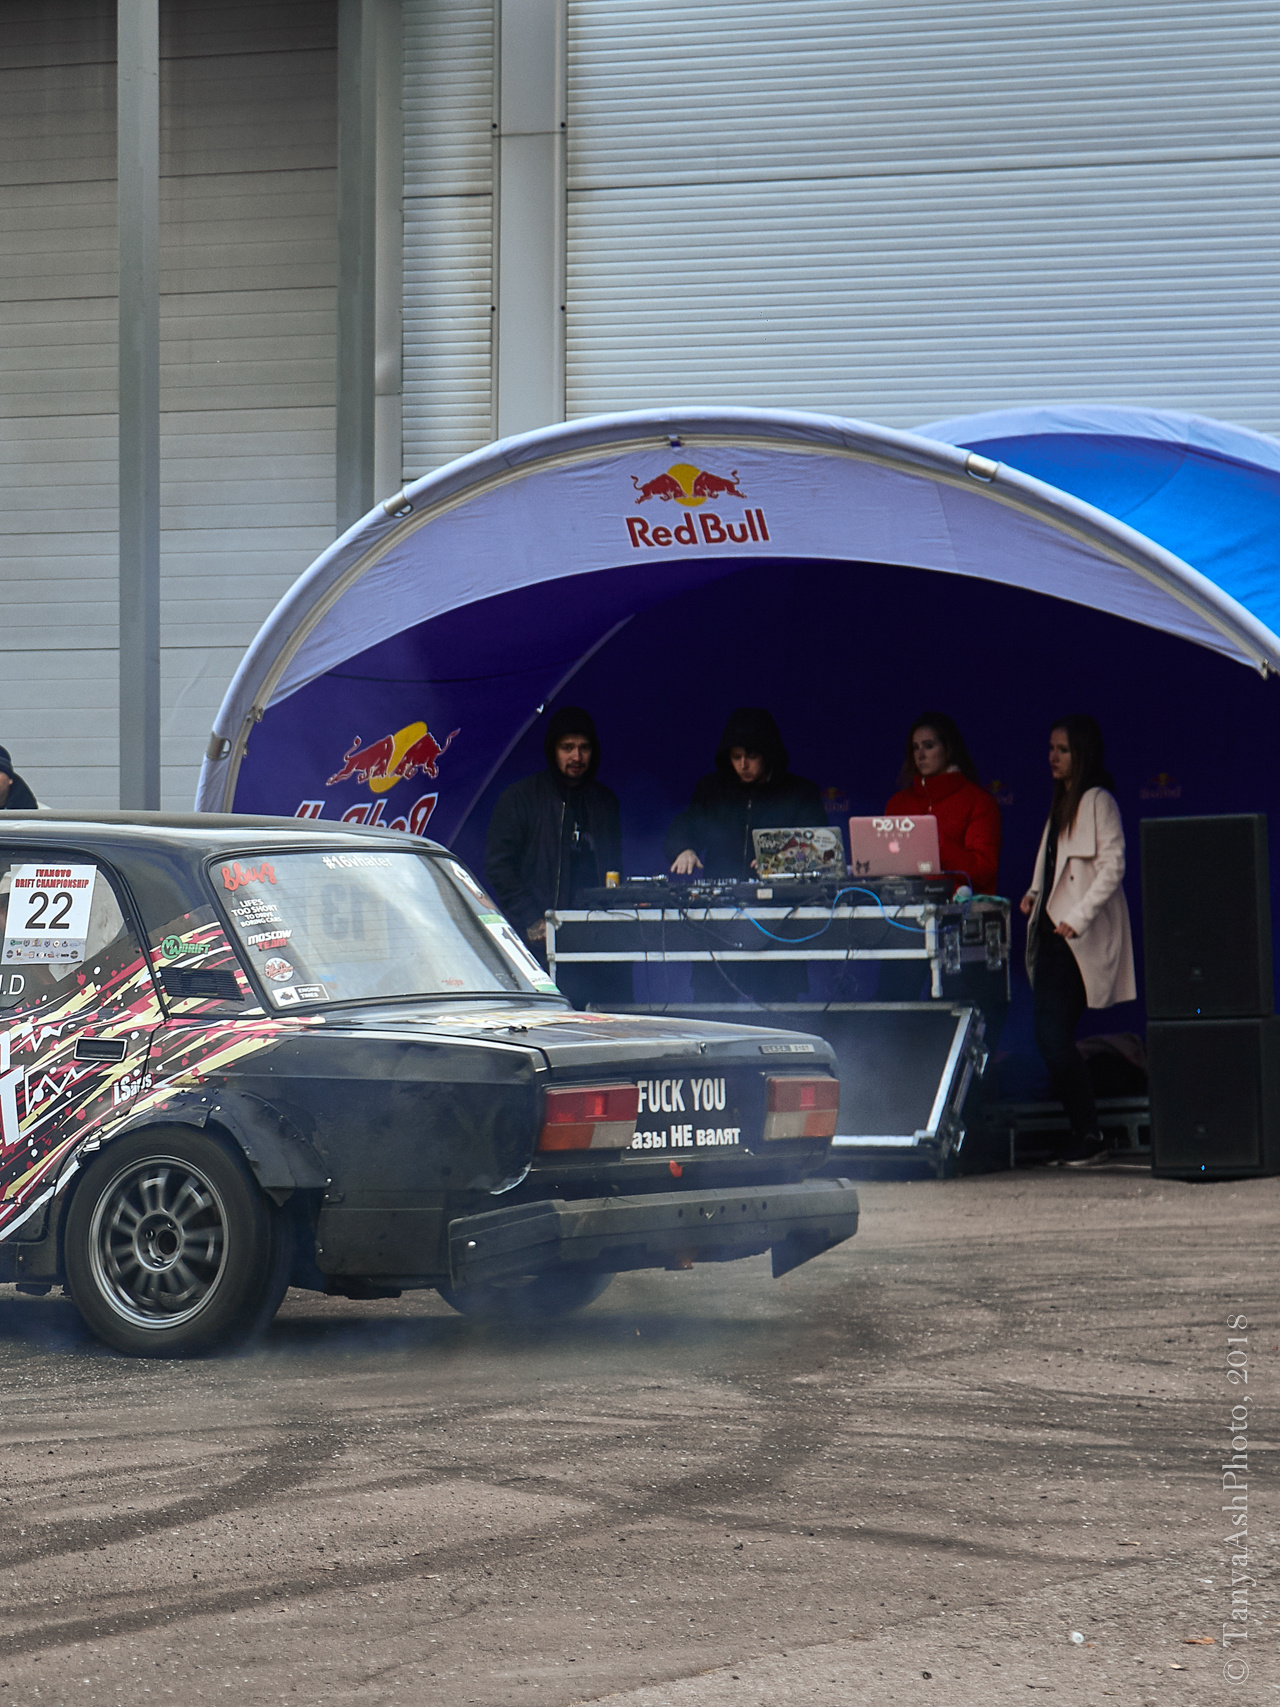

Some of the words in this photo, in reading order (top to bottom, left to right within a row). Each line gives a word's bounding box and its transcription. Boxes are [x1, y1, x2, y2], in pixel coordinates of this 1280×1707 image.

[625, 512, 699, 548] Red
[698, 508, 770, 544] Bull
[35, 869, 71, 878] IVANOVO
[15, 879, 35, 888] DRIFT
[36, 879, 89, 889] CHAMPIONSHIP
[24, 891, 73, 930] 22
[231, 907, 251, 917] TOO
[247, 929, 293, 946] MOSCOW
[257, 938, 287, 950] TEAM
[181, 943, 211, 954] DRIFT
[637, 1078, 686, 1113] FUCK
[690, 1077, 726, 1112] YOU
[626, 1131, 667, 1150] азы
[670, 1125, 693, 1148] НЕ
[695, 1127, 741, 1147] валят
